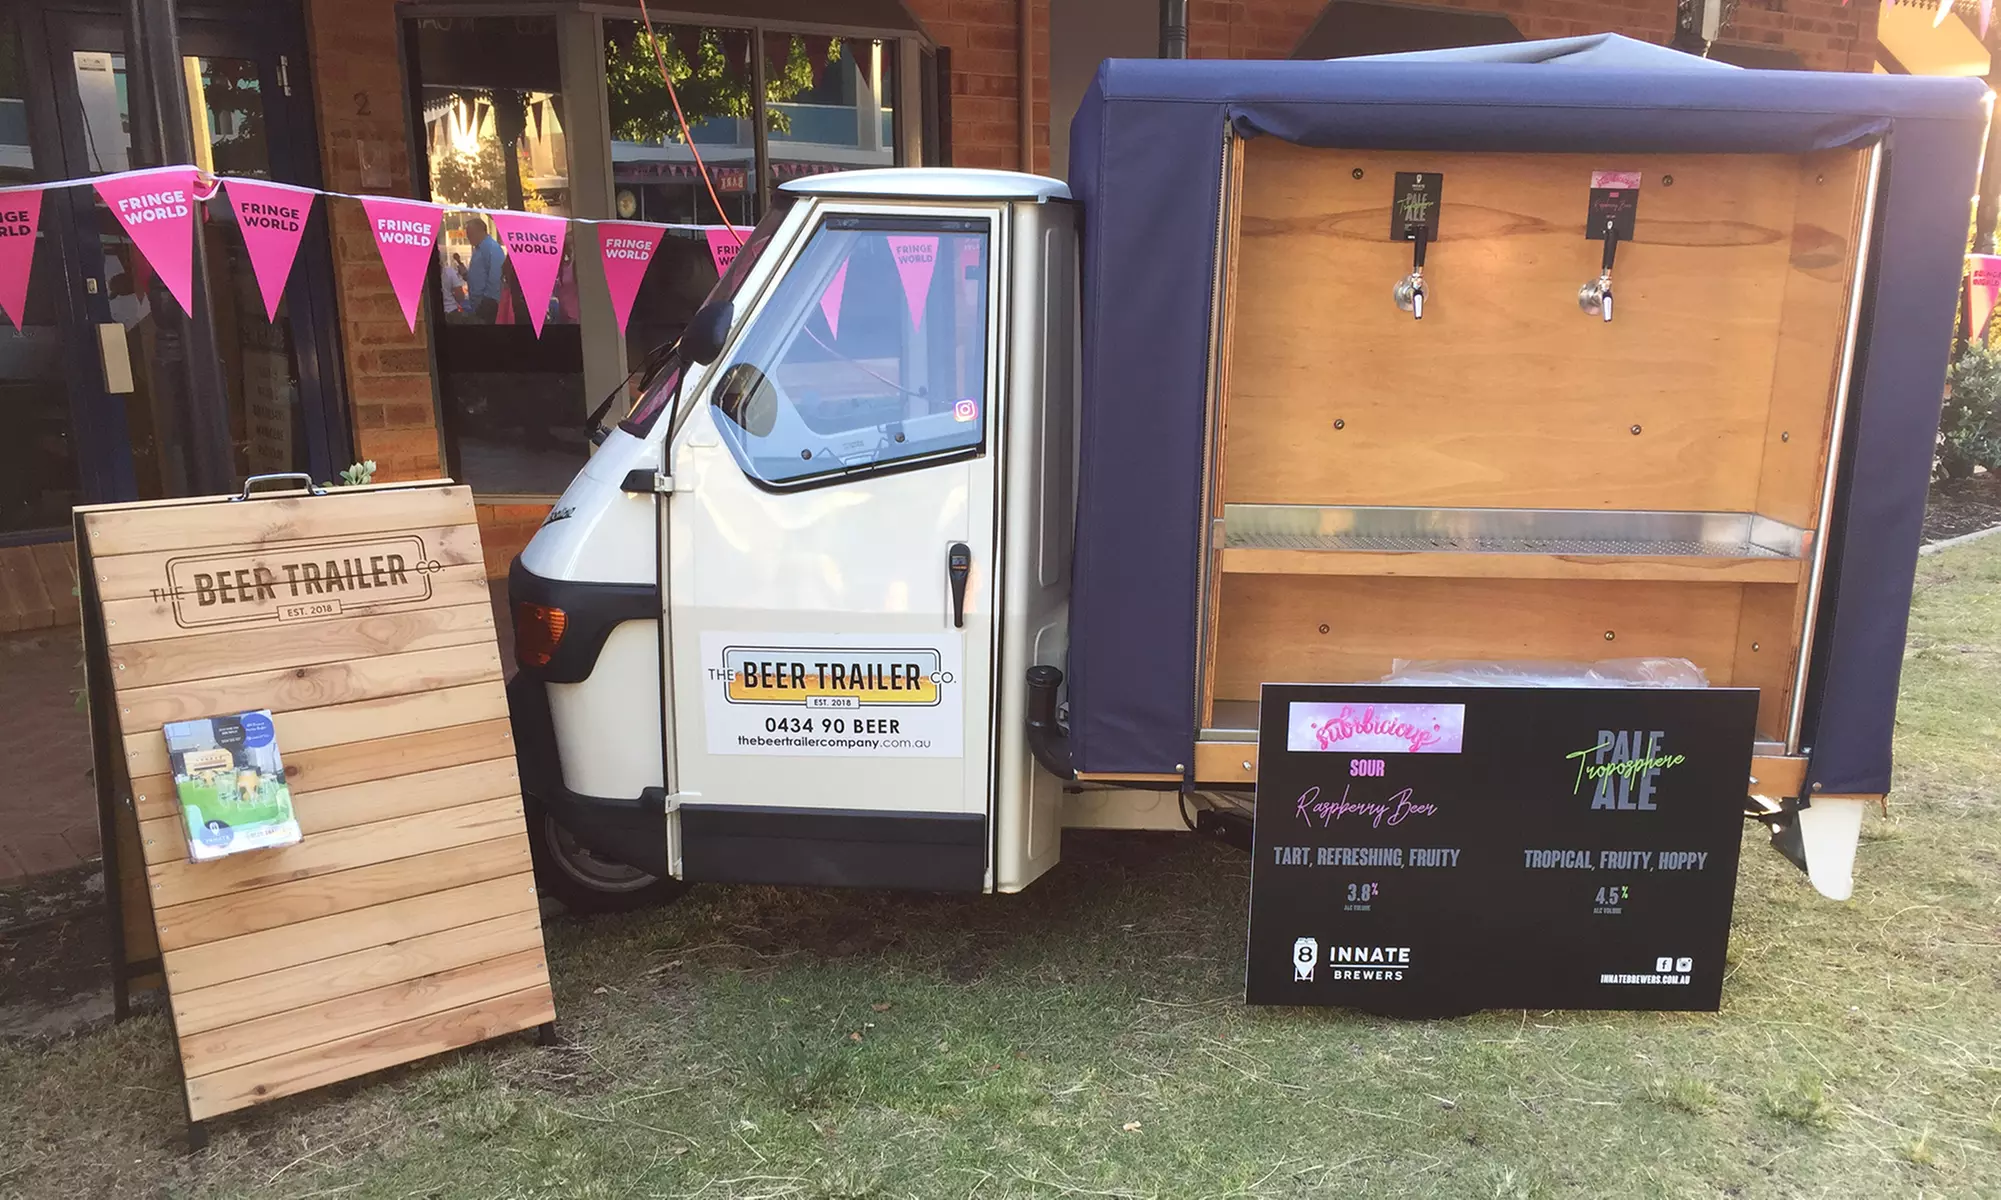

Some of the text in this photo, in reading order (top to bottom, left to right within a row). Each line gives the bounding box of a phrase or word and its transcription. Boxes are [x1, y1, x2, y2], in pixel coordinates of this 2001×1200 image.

[353, 92, 371, 116] 2
[118, 190, 187, 213] FRINGE
[124, 206, 189, 226] WORLD
[241, 202, 300, 221] FRINGE
[0, 224, 31, 237] RLD
[243, 215, 300, 233] WORLD
[377, 218, 432, 236] FRINGE
[379, 232, 432, 247] WORLD
[507, 231, 558, 245] FRINGE
[605, 238, 653, 251] FRINGE
[510, 243, 559, 256] WORLD
[605, 248, 650, 261] WORLD
[716, 245, 742, 255] FRIN
[896, 244, 933, 255] FRINGE
[898, 254, 933, 265] WORLD
[149, 554, 446, 607] THE BEER TRAILER CO.
[287, 604, 333, 618] EST. 2018
[708, 661, 957, 690] THE BEER TRAILER CO.
[813, 699, 852, 707] EST. 2018
[765, 717, 900, 735] 0434 90 BEER
[738, 735, 931, 750] thebeertrailercompany.com.au
[1596, 730, 1665, 766] PALE
[1349, 759, 1385, 777] SOUR
[1565, 737, 1686, 795] Troposphere
[1591, 767, 1661, 811] ALE
[1296, 784, 1438, 828] Raspberry Beer
[1273, 846, 1461, 869] TART, REFRESHING, FRUITY
[1524, 849, 1709, 872] TROPICAL, FRUITY, HOPPY
[1347, 882, 1379, 902] 3.8%
[1594, 885, 1629, 905] 4.5%
[1298, 946, 1411, 963] 8 INNATE
[1333, 970, 1403, 981] BREWERS
[1600, 973, 1691, 985] INNATEBREWERS.COM.AU
